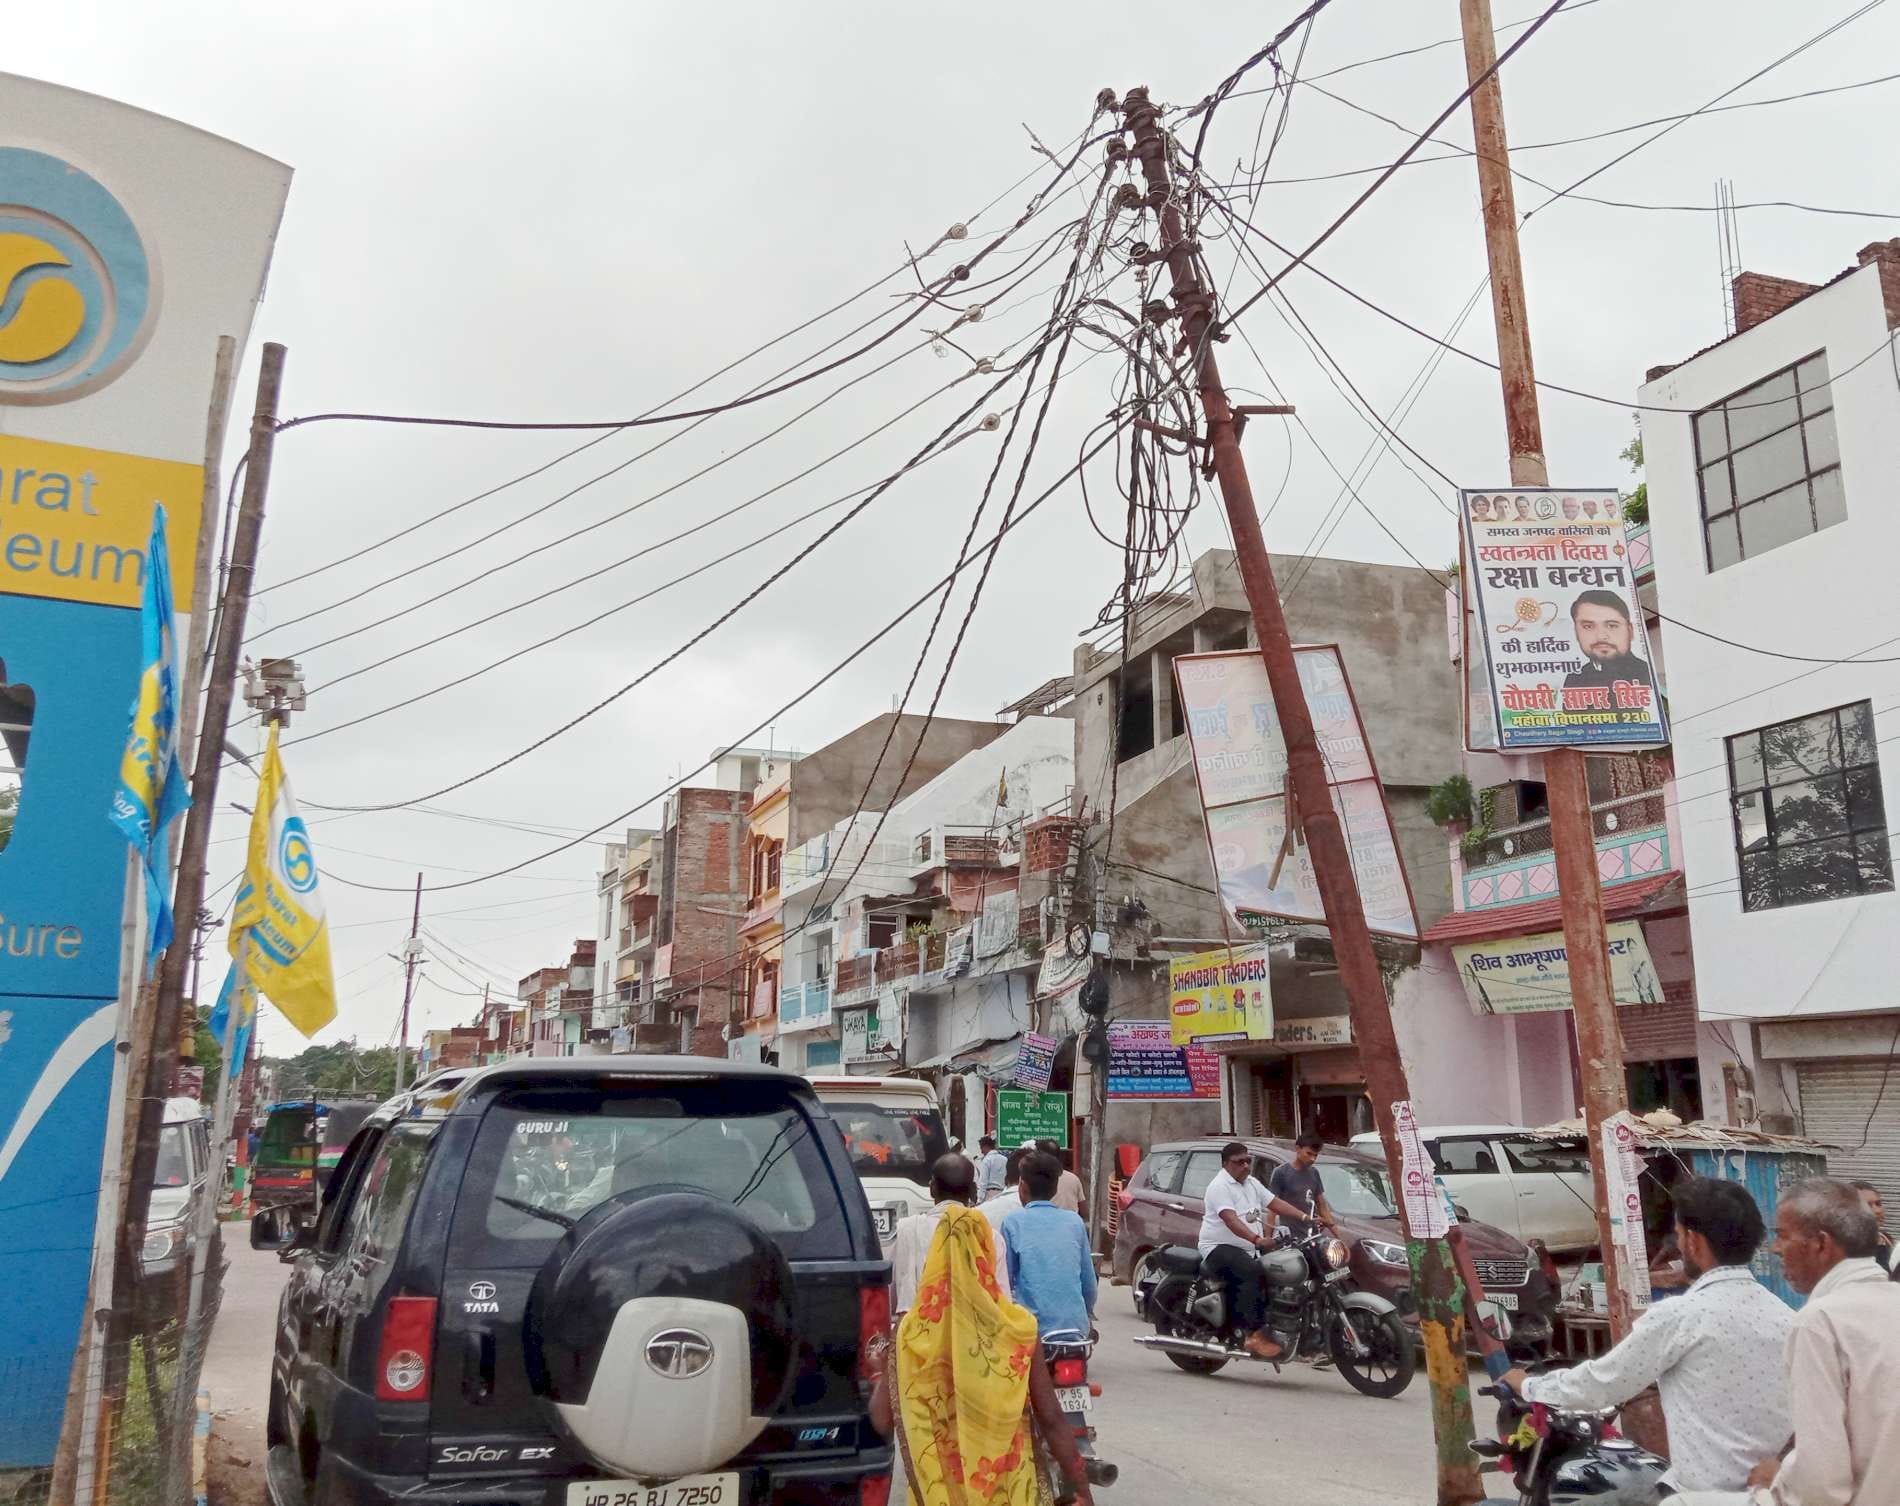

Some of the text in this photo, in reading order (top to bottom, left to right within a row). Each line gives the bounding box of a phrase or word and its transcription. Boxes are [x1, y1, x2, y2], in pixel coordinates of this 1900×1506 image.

[0, 468, 99, 517] rat
[1487, 527, 1520, 537] समस्त
[1522, 527, 1556, 537] जनपद
[1596, 525, 1611, 537] को
[0, 532, 147, 586] eum
[1561, 538, 1609, 562] दिवस
[1485, 565, 1627, 590] रक्षा बन्धन
[1500, 635, 1571, 654] की हार्दिक
[1495, 656, 1584, 679] शुभकामनाएं
[1561, 686, 1611, 712] सागर
[1613, 678, 1653, 708] सिंह
[1622, 711, 1651, 723] 230
[0, 910, 82, 959] ure
[1470, 946, 1568, 973] शिव आभूषण
[1221, 958, 1267, 985] TRADERS
[844, 1015, 867, 1033] OKAYA
[1130, 1029, 1160, 1040] अखण्ड
[1161, 1030, 1171, 1040] ज
[516, 1121, 569, 1134] GURU JI
[463, 1302, 500, 1313] TATA
[1070, 1388, 1083, 1399] 95
[1063, 1400, 1088, 1410] 1634
[518, 1446, 558, 1461] EX
[677, 1485, 723, 1505] 7250
